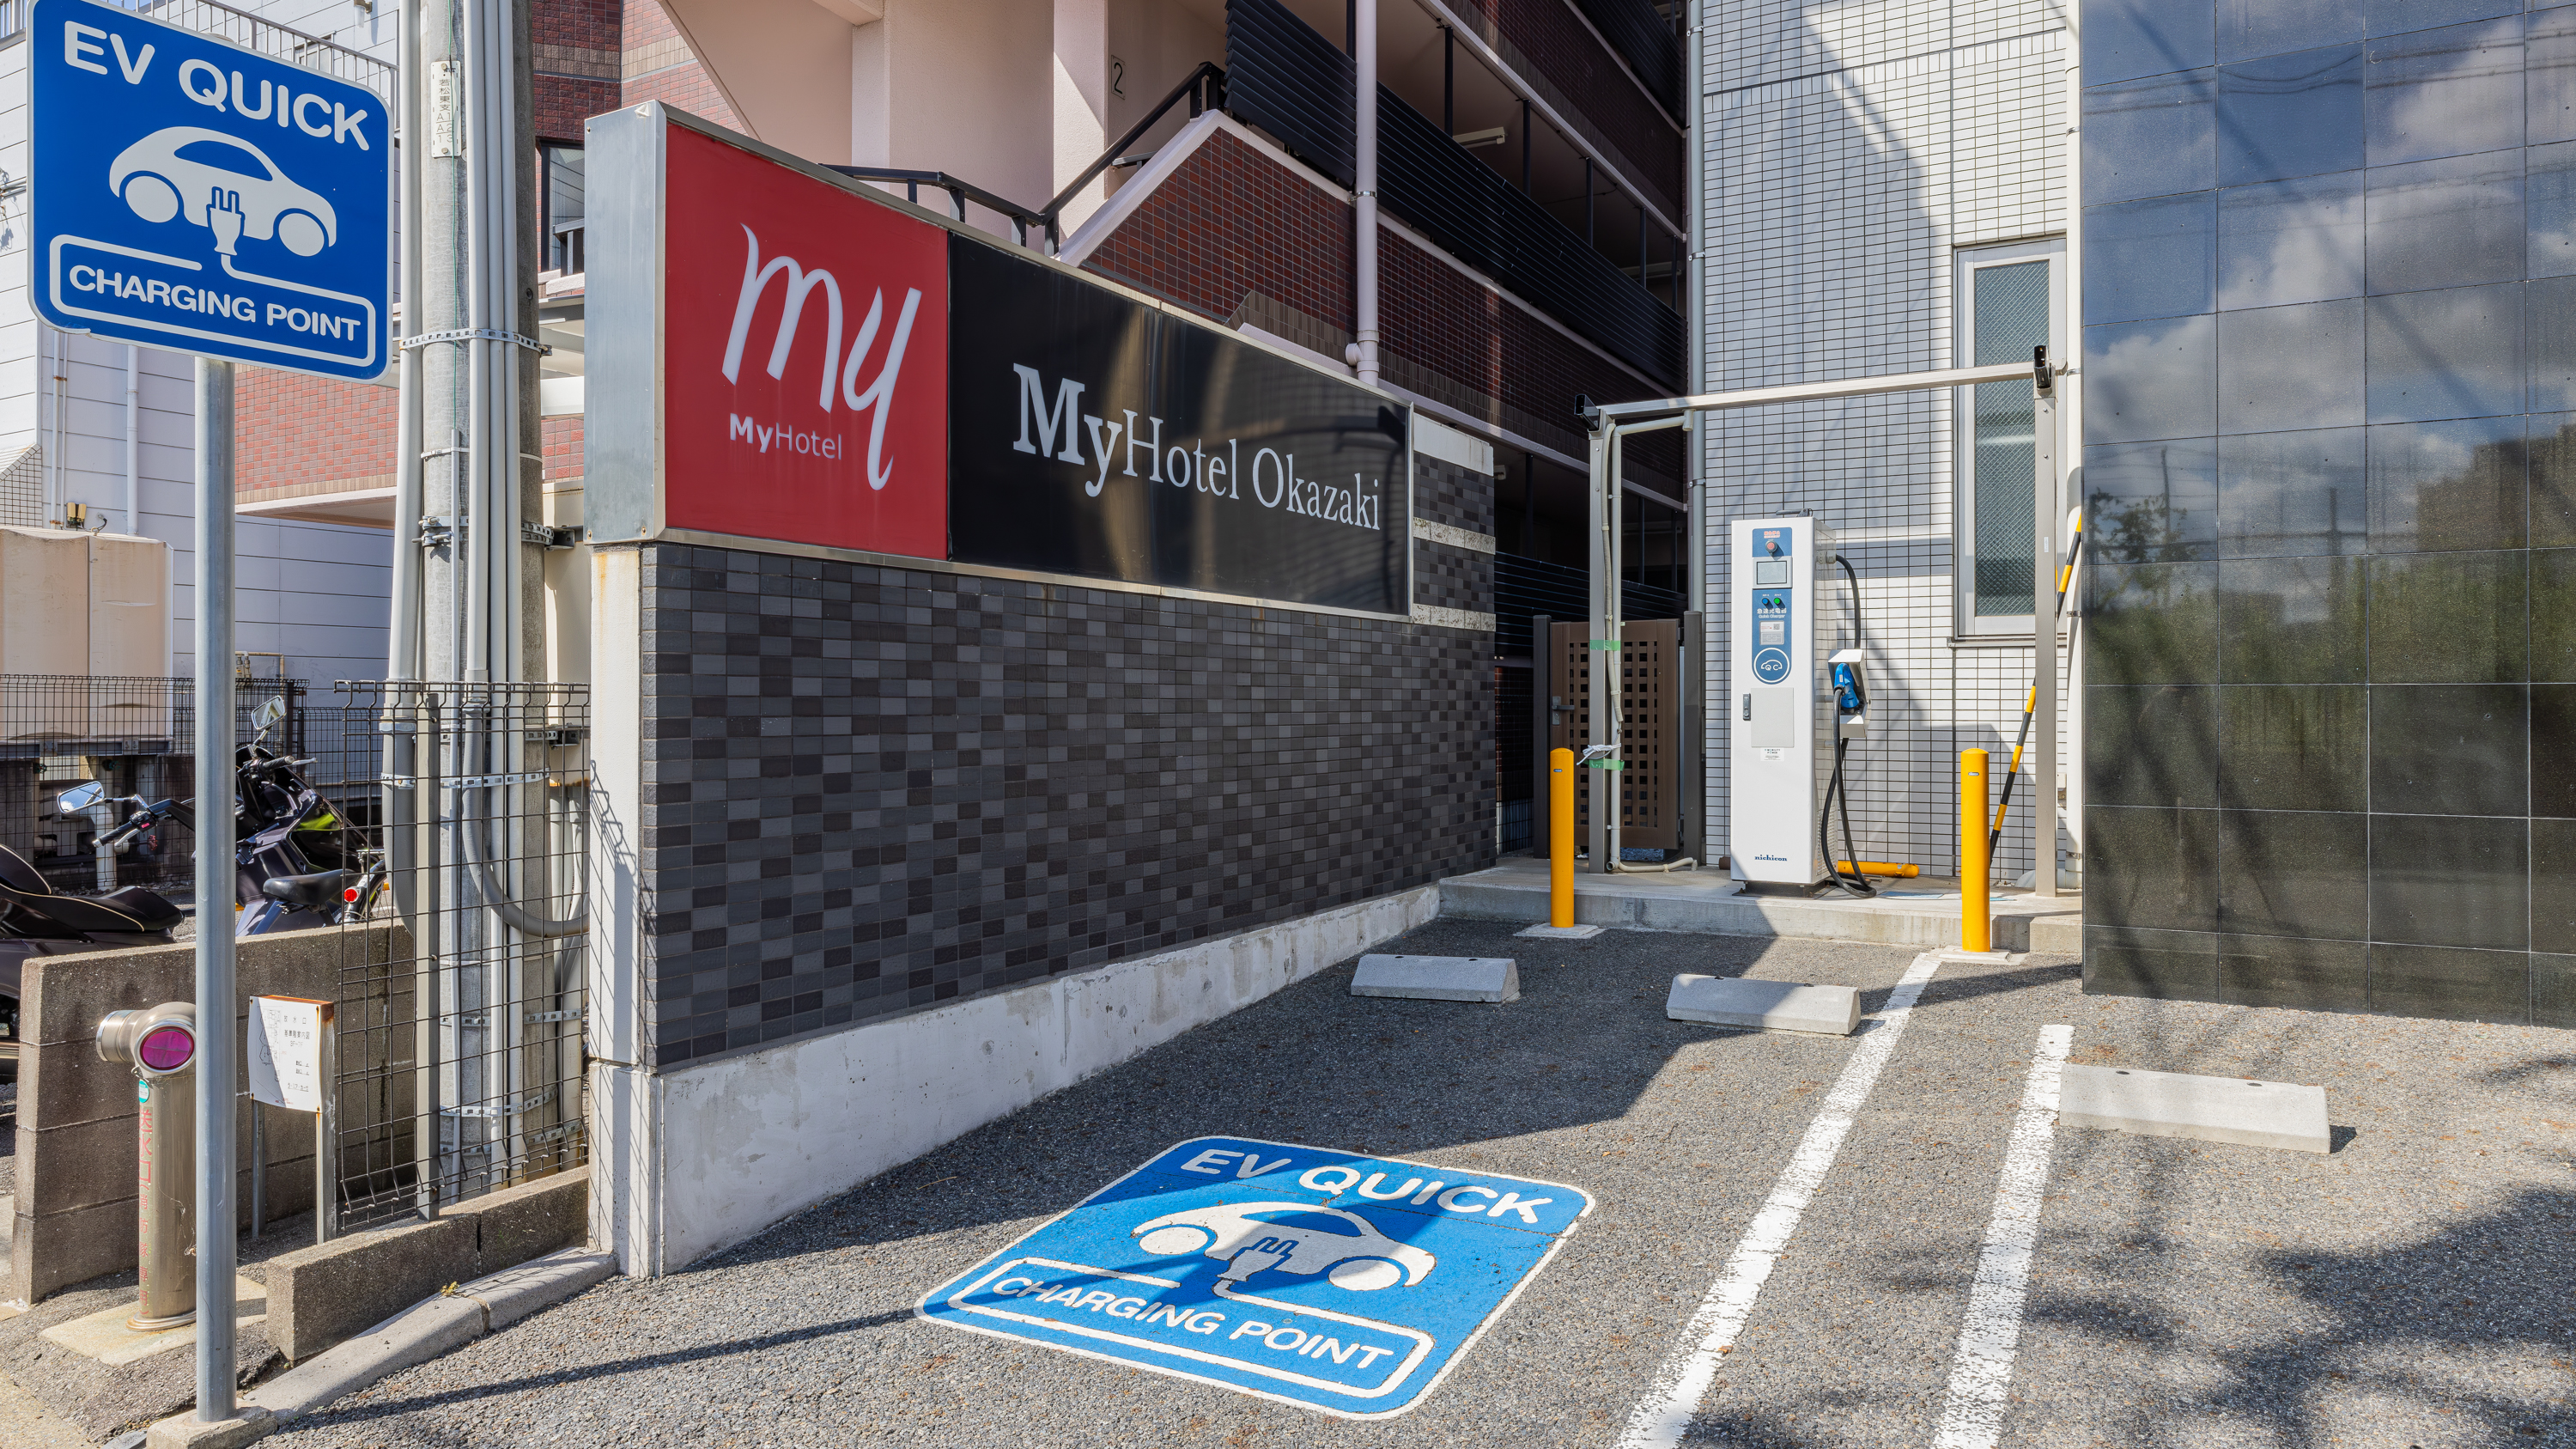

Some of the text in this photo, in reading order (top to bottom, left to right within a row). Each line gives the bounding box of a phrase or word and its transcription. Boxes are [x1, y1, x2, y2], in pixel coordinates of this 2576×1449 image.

[64, 20, 370, 151] EV QUICK
[1113, 61, 1123, 95] 2
[69, 265, 361, 342] CHARGING POINT
[730, 412, 842, 460] MyHotel
[1012, 362, 1381, 531] MyHotel Okazaki
[1180, 1148, 1553, 1225] EV QUICK
[992, 1276, 1395, 1370] CHARGING POINT
